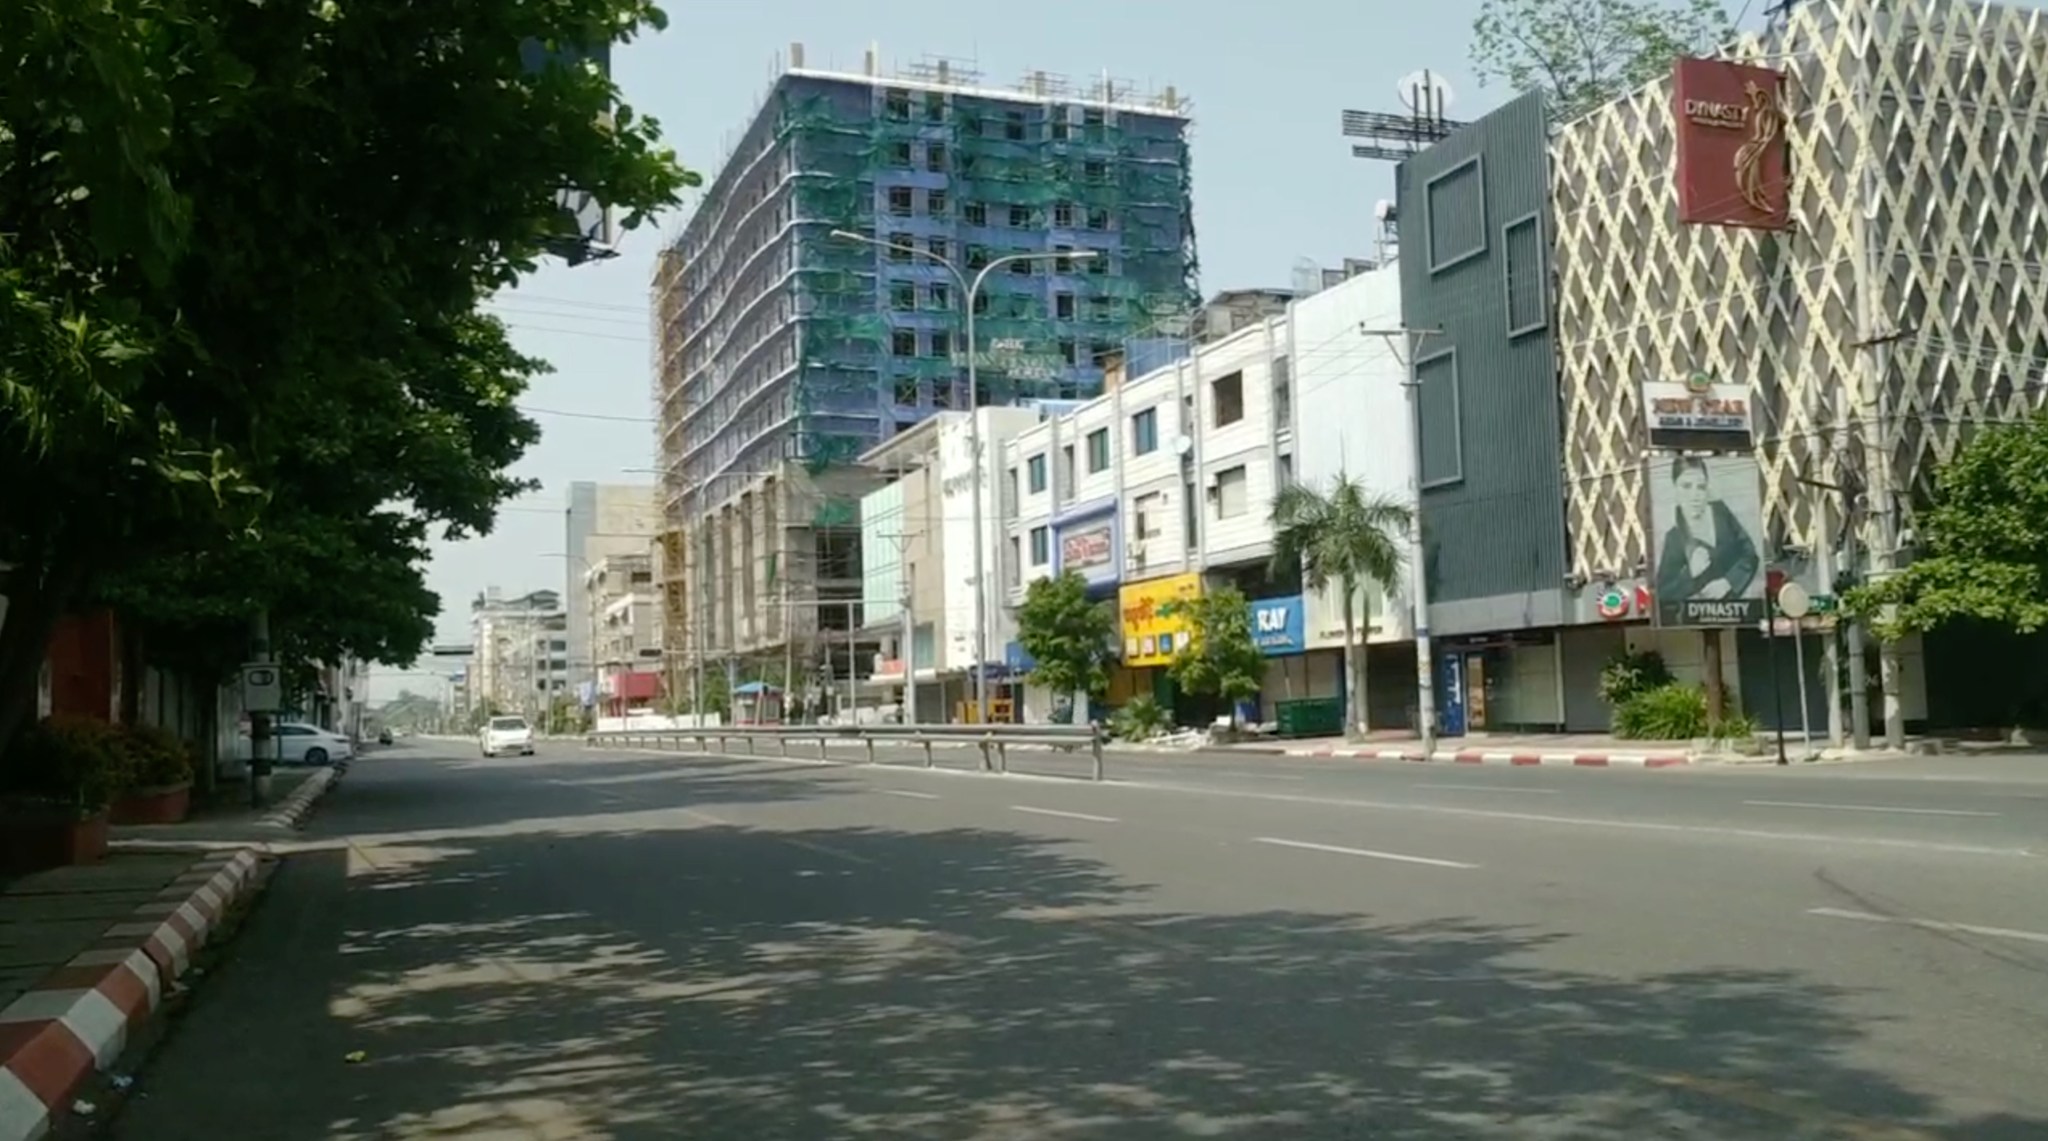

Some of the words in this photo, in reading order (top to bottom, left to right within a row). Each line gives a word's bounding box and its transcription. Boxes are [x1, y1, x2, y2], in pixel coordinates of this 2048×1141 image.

[1685, 99, 1749, 121] DYNASTY
[1257, 607, 1288, 632] RAY
[1688, 602, 1750, 617] DYNASTY
